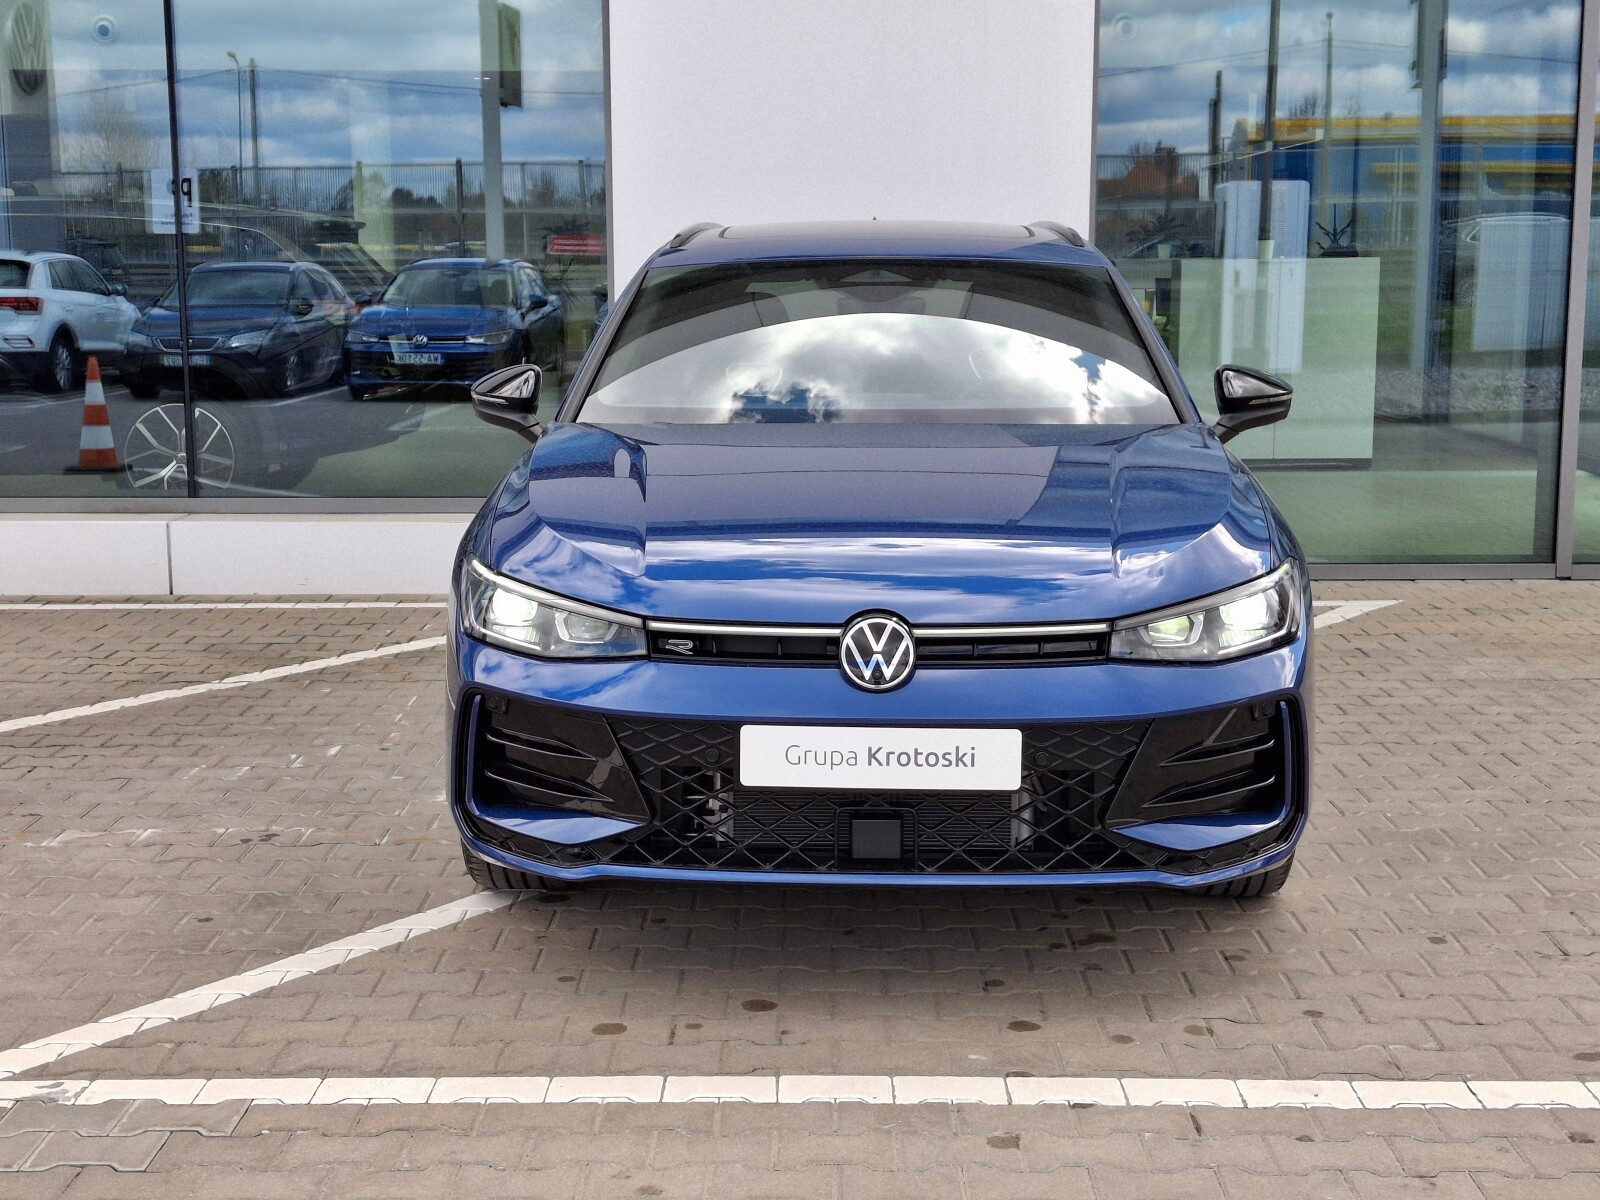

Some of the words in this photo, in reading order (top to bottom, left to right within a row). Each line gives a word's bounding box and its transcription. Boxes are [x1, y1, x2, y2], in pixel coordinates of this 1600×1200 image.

[841, 618, 914, 690] VW
[785, 744, 858, 771] Grupa
[866, 745, 976, 768] Krotoski
